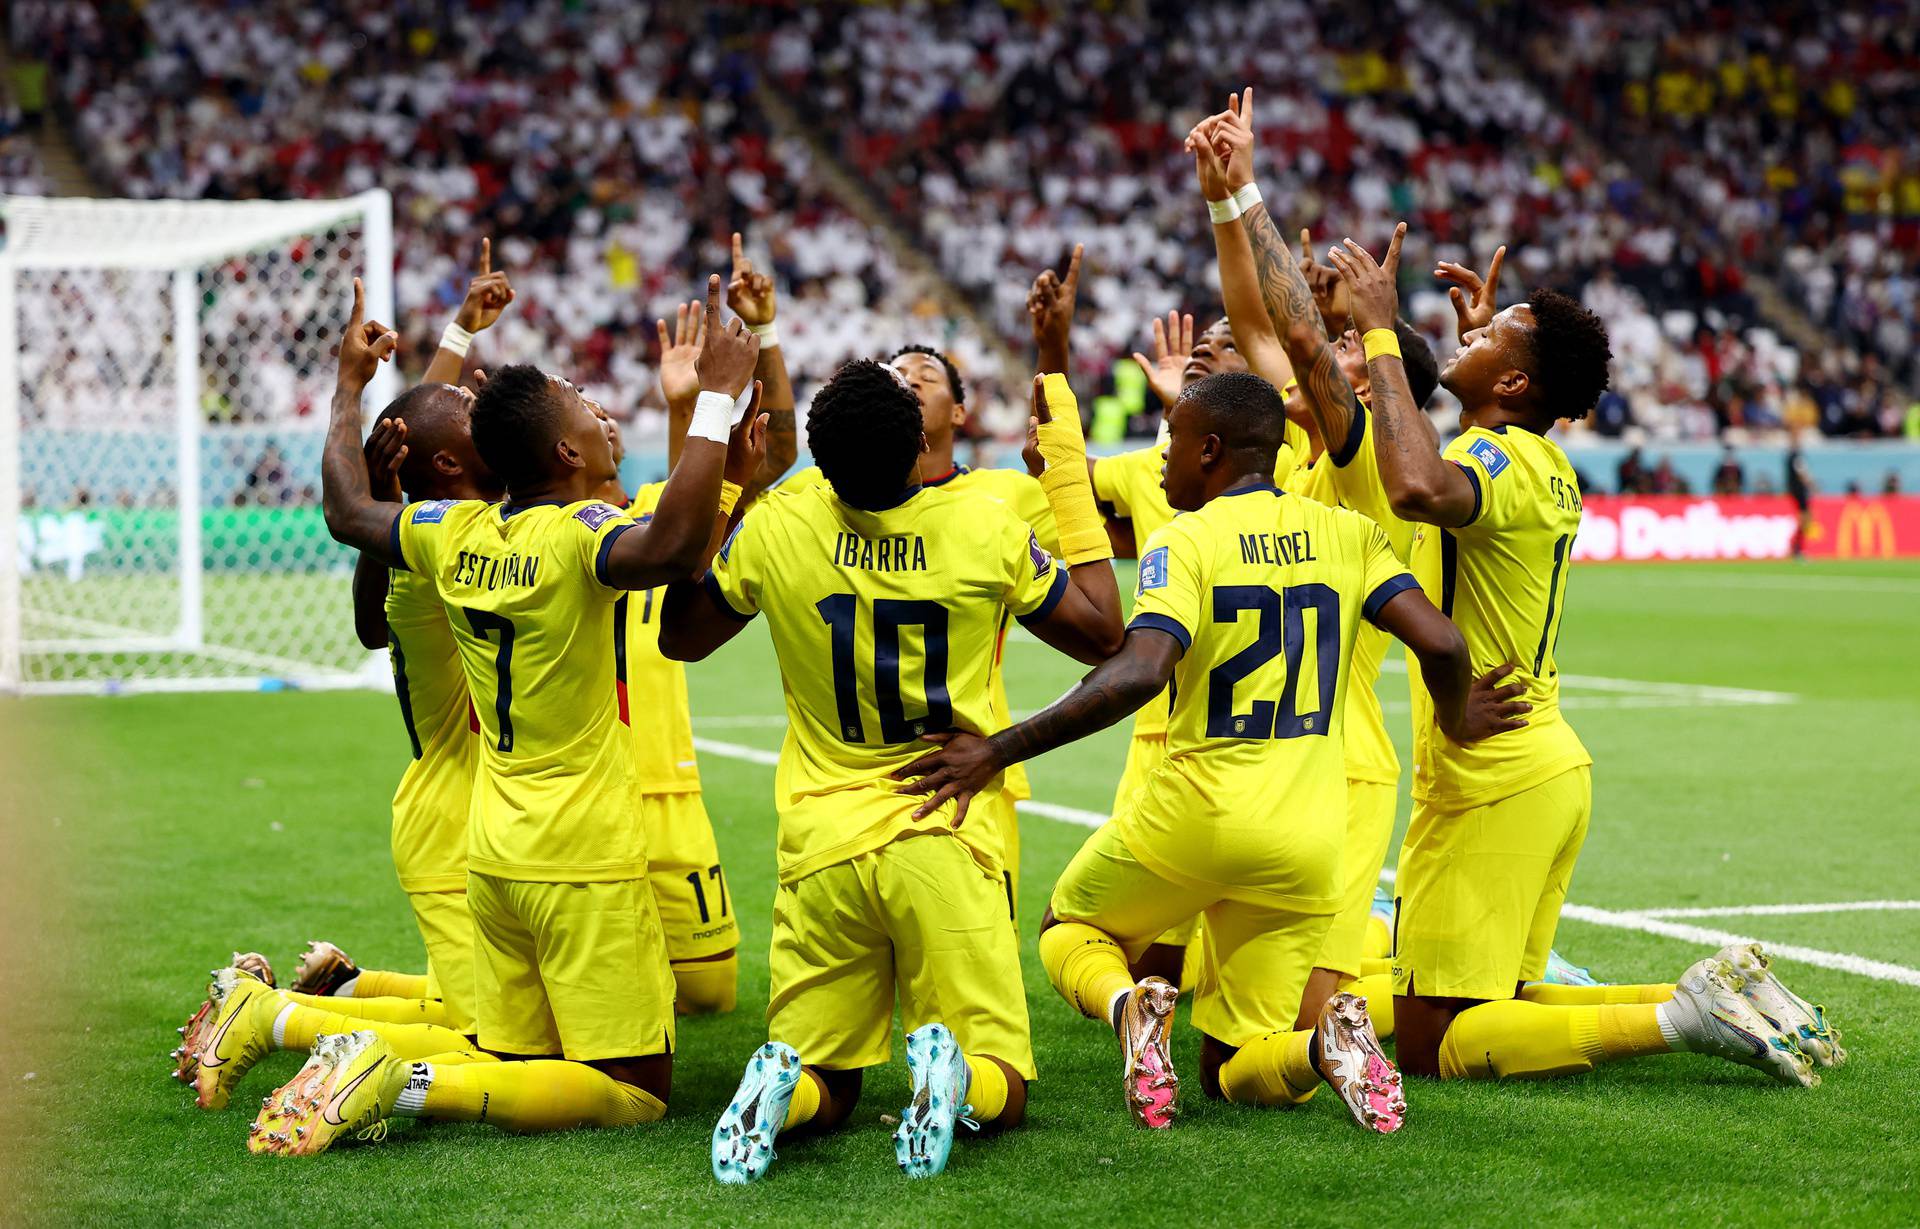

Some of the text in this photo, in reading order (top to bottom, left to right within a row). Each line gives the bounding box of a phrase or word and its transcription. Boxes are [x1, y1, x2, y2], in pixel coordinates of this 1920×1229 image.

[834, 531, 927, 571] IBARRA
[1620, 502, 1795, 558] Deliver
[462, 606, 516, 753] 7
[815, 593, 953, 744] 10
[1206, 583, 1340, 739] 20
[686, 864, 727, 924] 17
